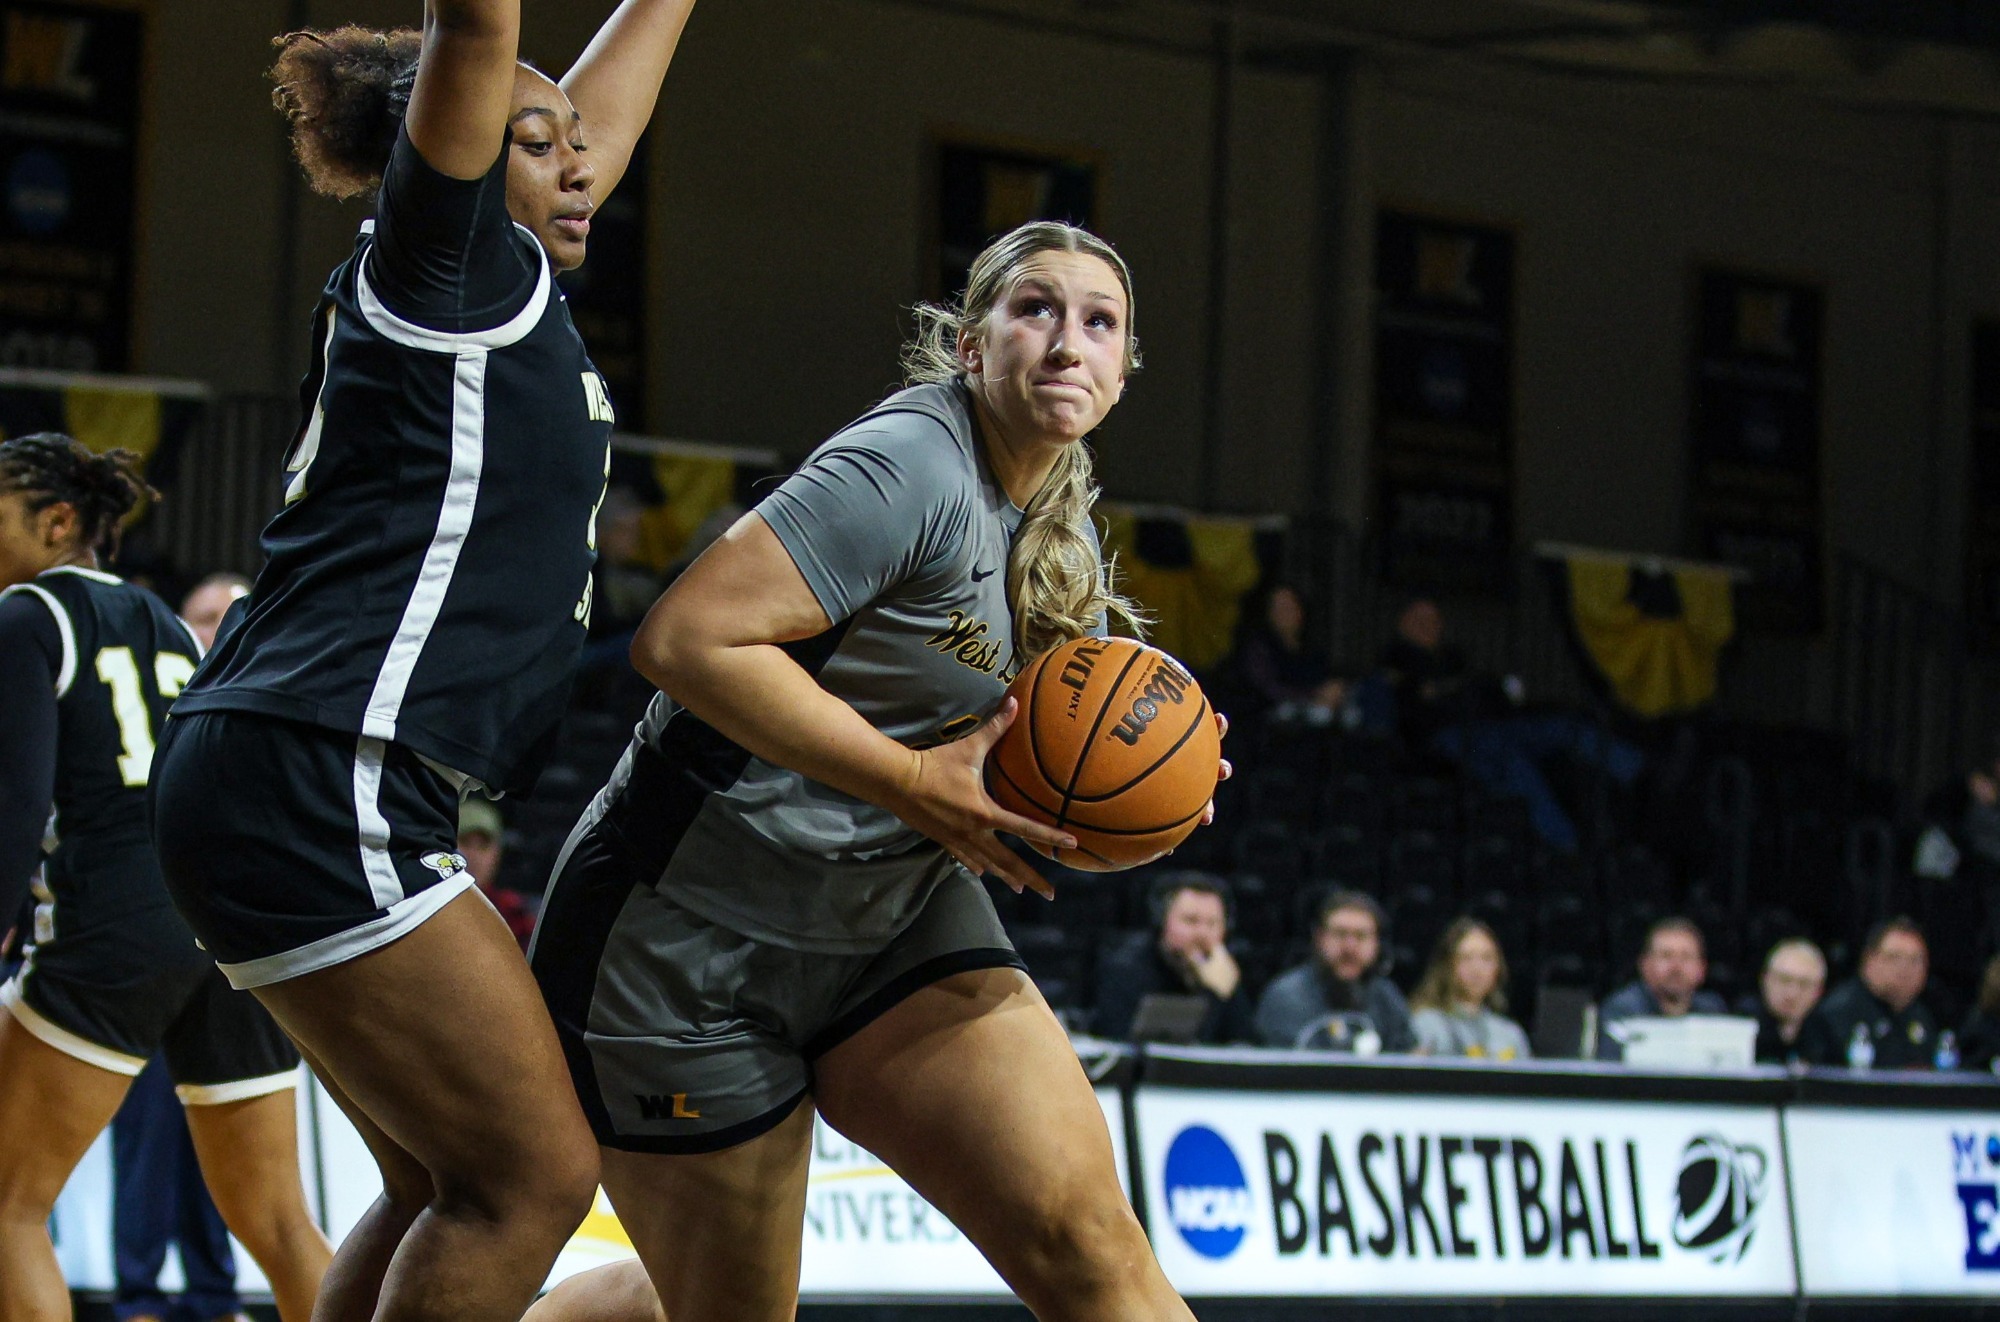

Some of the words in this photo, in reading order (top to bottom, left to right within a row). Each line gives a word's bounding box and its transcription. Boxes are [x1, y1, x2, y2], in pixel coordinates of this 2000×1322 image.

[924, 609, 1002, 674] West
[1060, 637, 1113, 691] EVO
[1067, 690, 1081, 722] NXT
[1109, 656, 1192, 747] Wilson
[633, 1092, 702, 1119] WL
[1264, 1130, 1661, 1259] BASKETBALL
